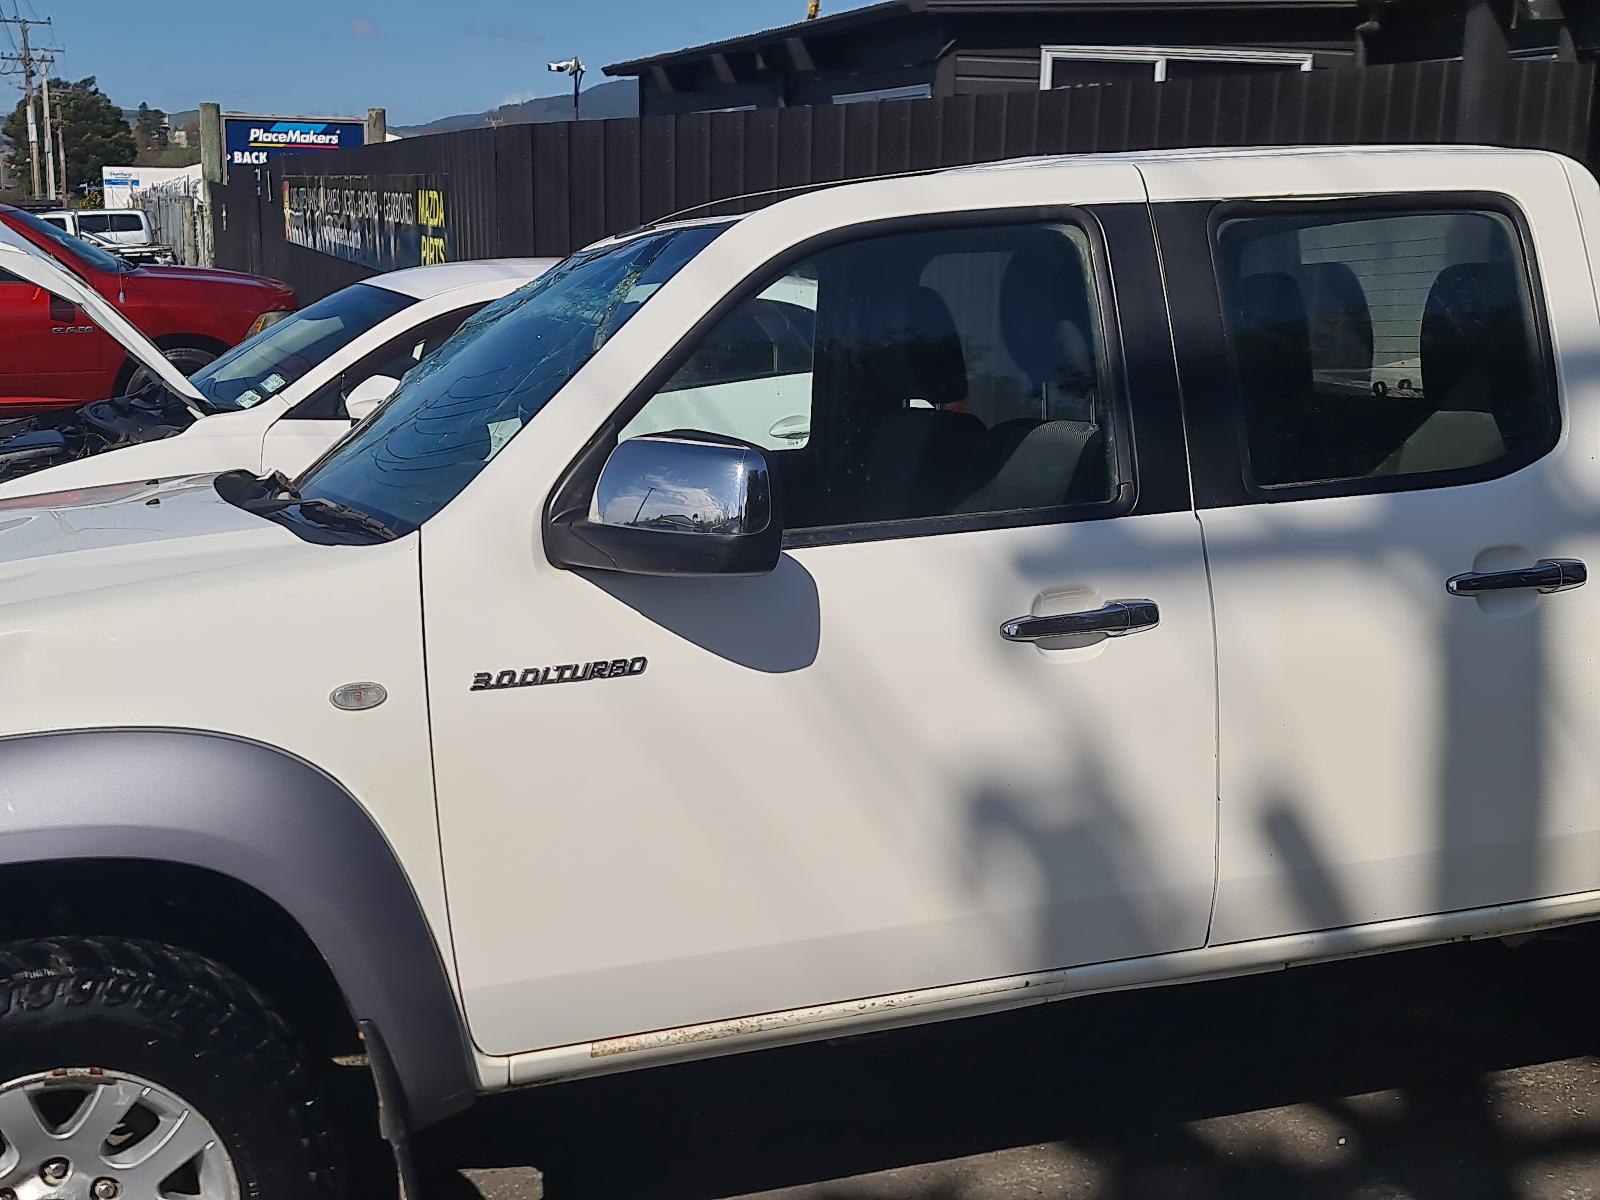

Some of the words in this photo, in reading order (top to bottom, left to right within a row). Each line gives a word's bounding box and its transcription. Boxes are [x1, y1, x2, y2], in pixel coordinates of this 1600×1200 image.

[249, 128, 339, 144] PlaceMakers
[233, 151, 268, 164] BACK
[418, 189, 446, 228] MAZDA
[421, 235, 446, 266] PARTS
